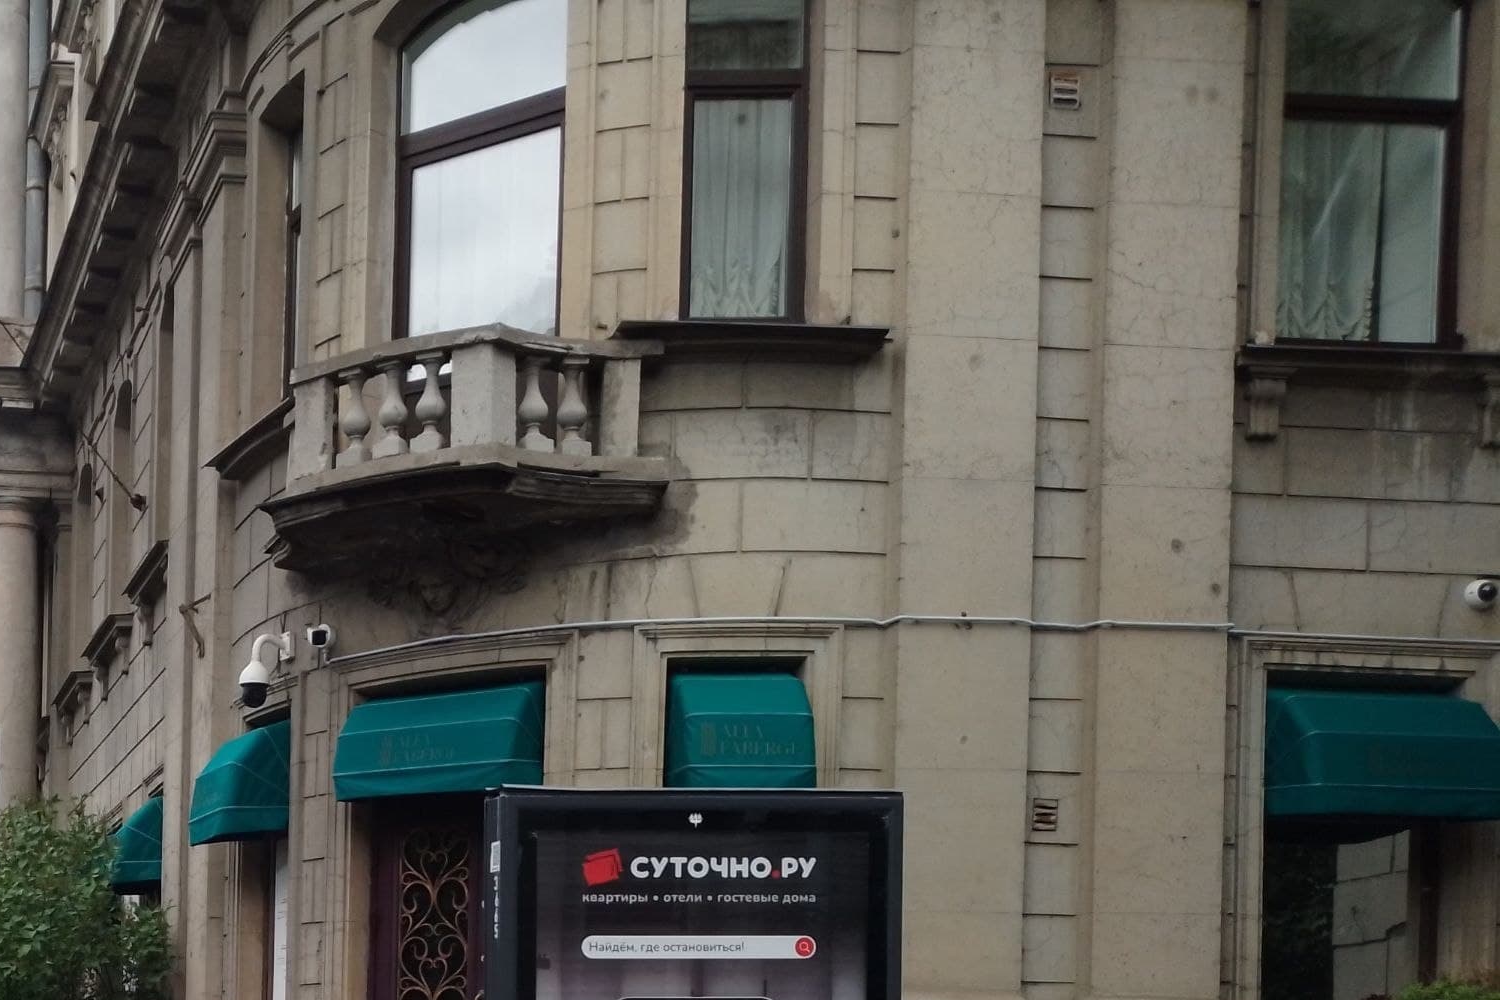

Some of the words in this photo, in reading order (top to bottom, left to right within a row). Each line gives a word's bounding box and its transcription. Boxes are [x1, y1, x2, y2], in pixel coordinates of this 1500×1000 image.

[630, 856, 817, 879] СУТОЧНО.РУ
[582, 893, 648, 905] квартиры
[663, 893, 702, 903] отели
[717, 893, 779, 904] гостевые
[782, 893, 817, 904] дома
[589, 941, 639, 954] Найдём,
[641, 943, 661, 954] где
[663, 941, 745, 952] остановиться!
